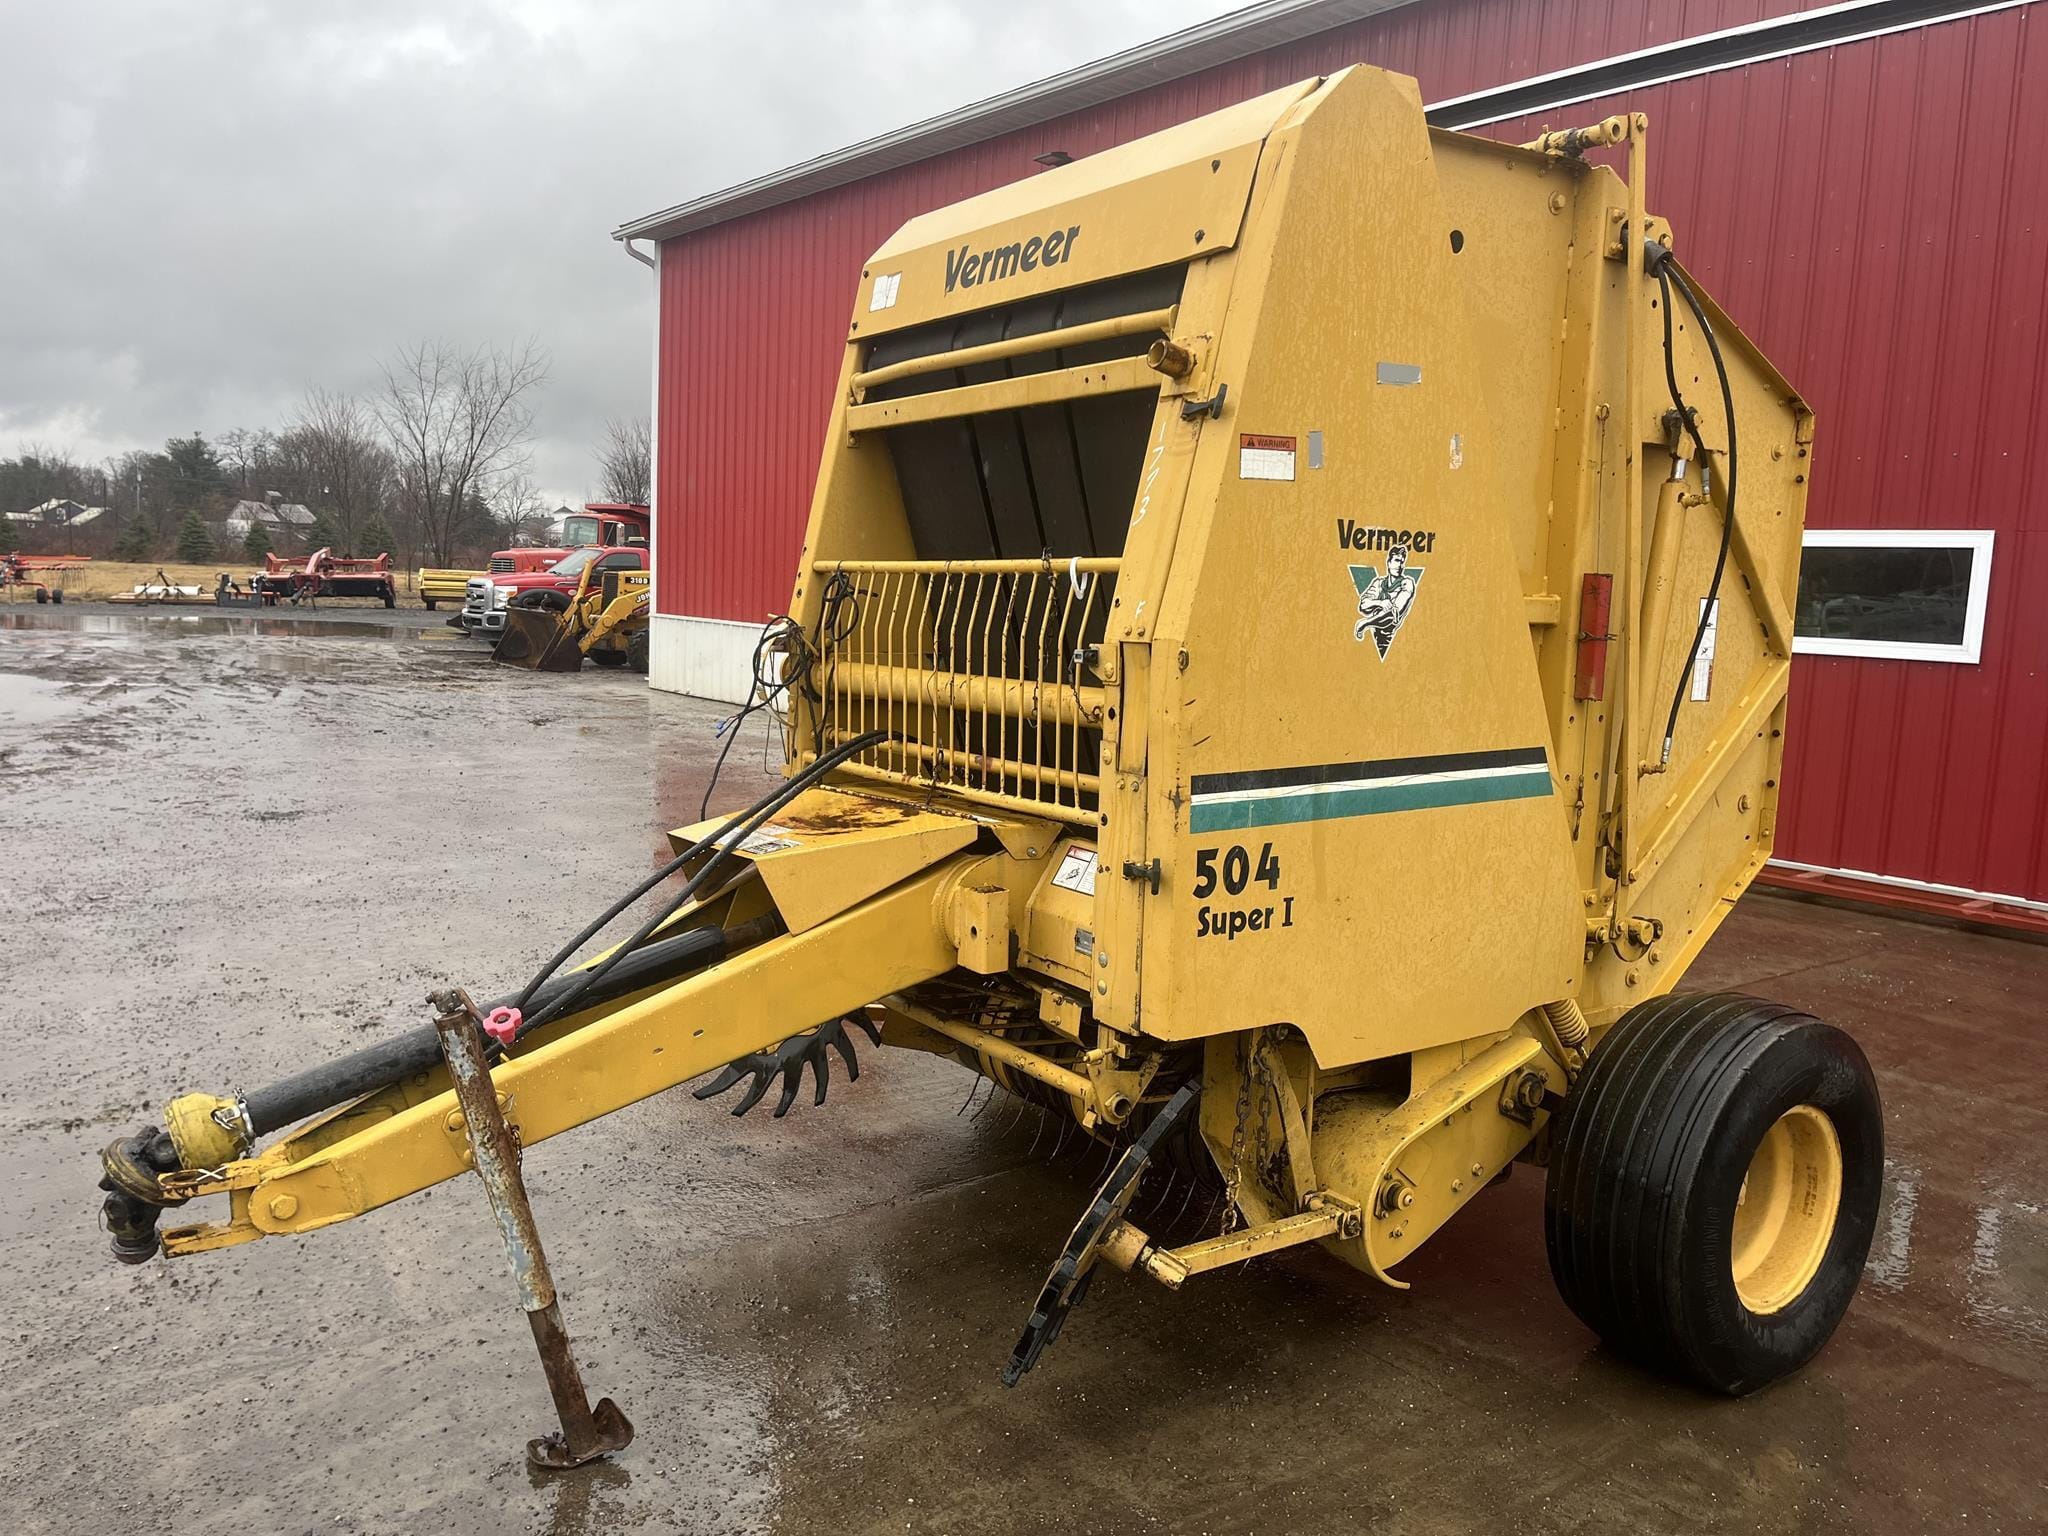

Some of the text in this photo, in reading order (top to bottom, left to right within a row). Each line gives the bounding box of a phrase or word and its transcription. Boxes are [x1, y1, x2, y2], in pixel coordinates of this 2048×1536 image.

[944, 225, 1081, 293] Vermeer
[1257, 438, 1291, 449] WARNING
[1337, 518, 1436, 553] Vermeer
[1192, 842, 1281, 899] 504
[1196, 896, 1295, 941] Super I
